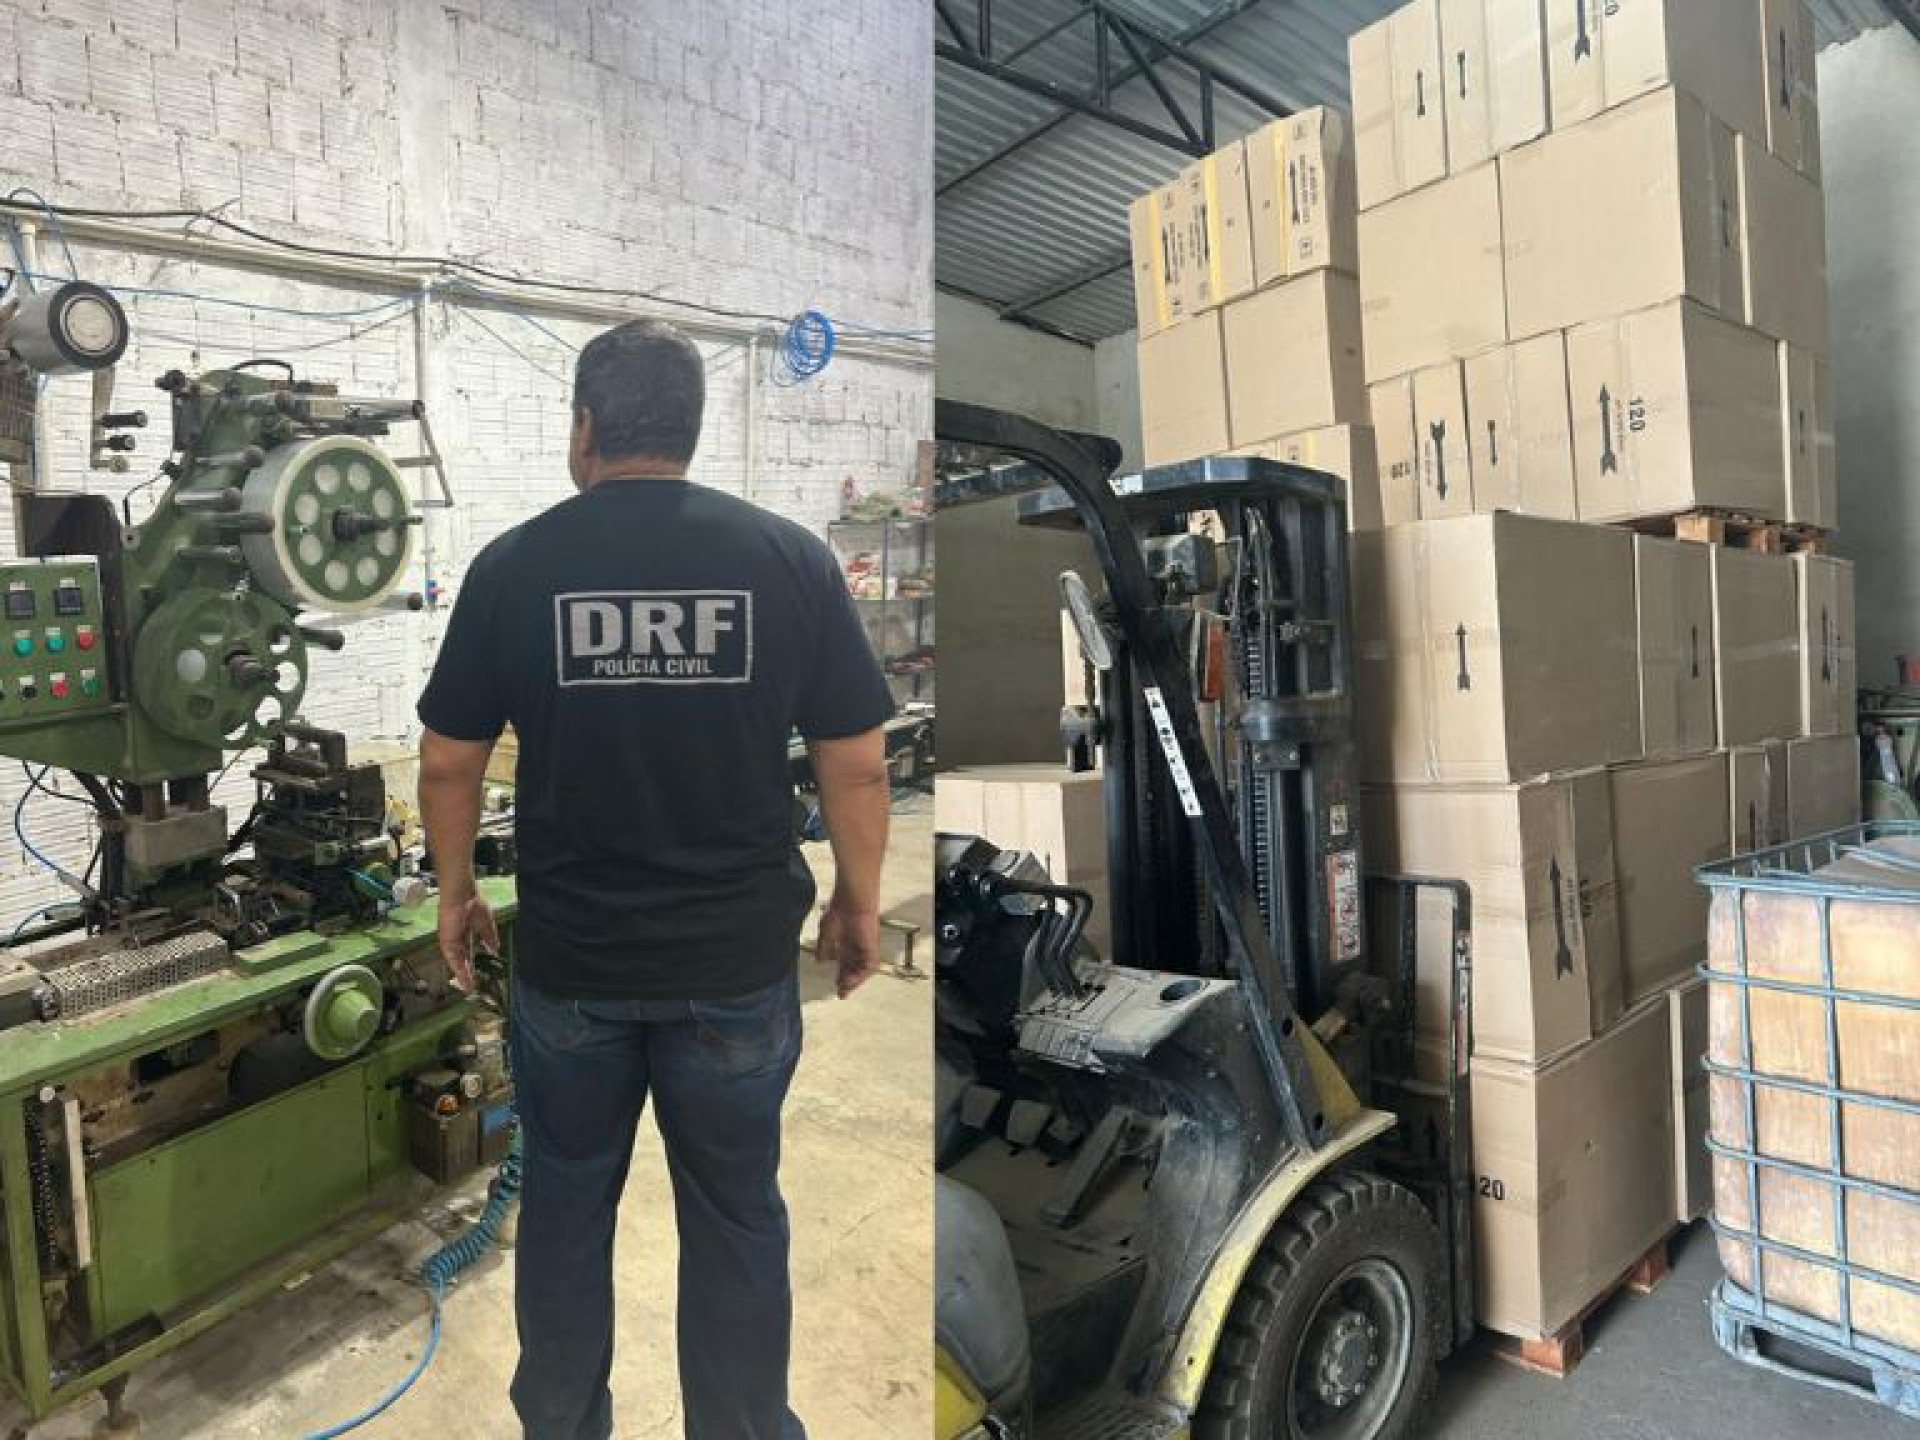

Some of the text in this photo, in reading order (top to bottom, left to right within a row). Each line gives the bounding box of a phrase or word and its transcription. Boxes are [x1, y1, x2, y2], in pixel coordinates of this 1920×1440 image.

[1629, 395, 1645, 432] 120
[570, 600, 736, 656] DRF
[666, 659, 714, 676] CIVIL
